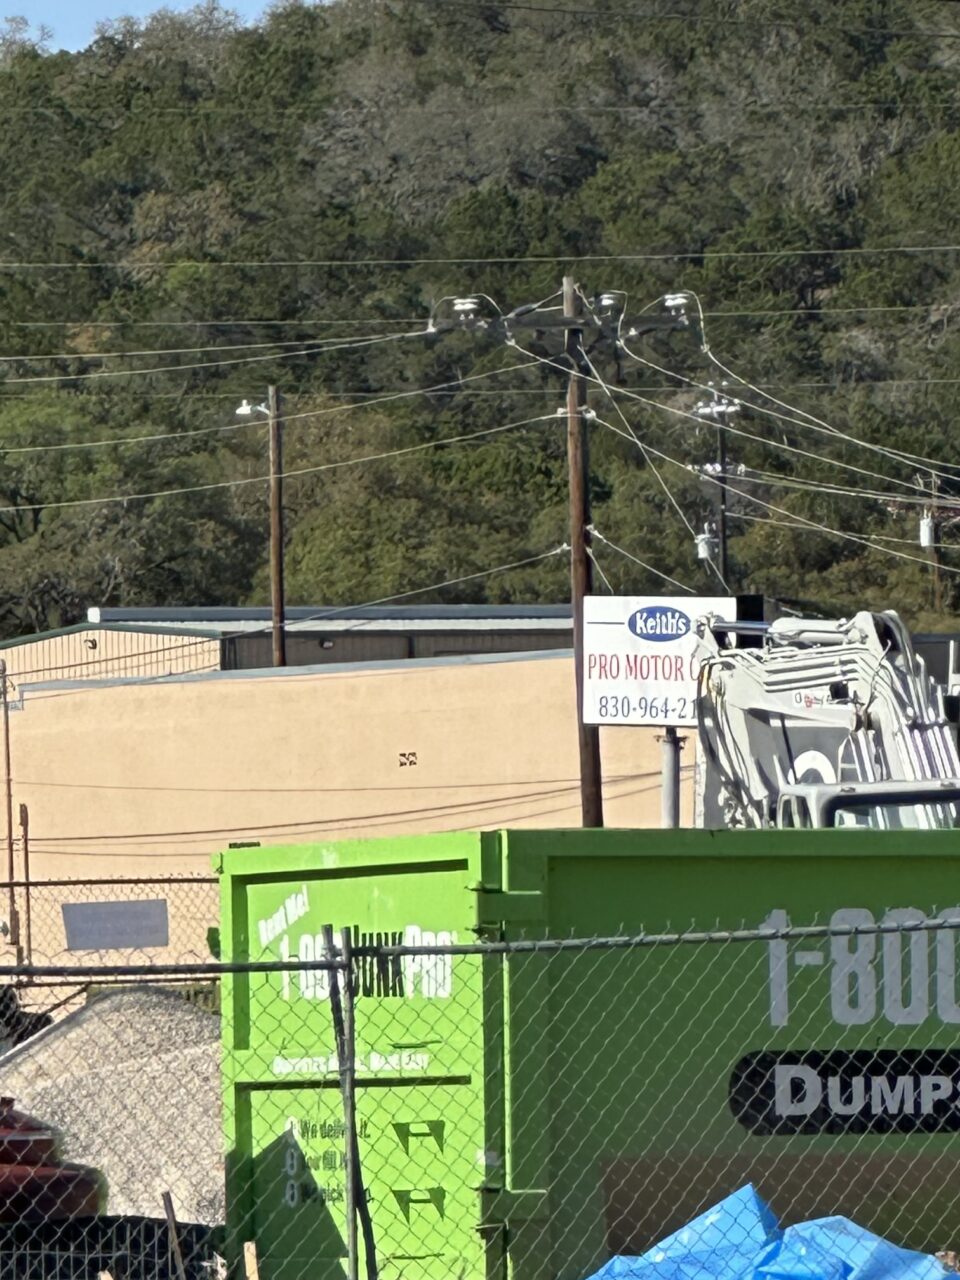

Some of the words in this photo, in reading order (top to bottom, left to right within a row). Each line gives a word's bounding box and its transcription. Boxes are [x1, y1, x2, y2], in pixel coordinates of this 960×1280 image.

[635, 612, 688, 635] Keith's
[588, 653, 620, 680] PRO
[625, 653, 685, 681] MOTOR
[599, 695, 698, 720] 830-964-21
